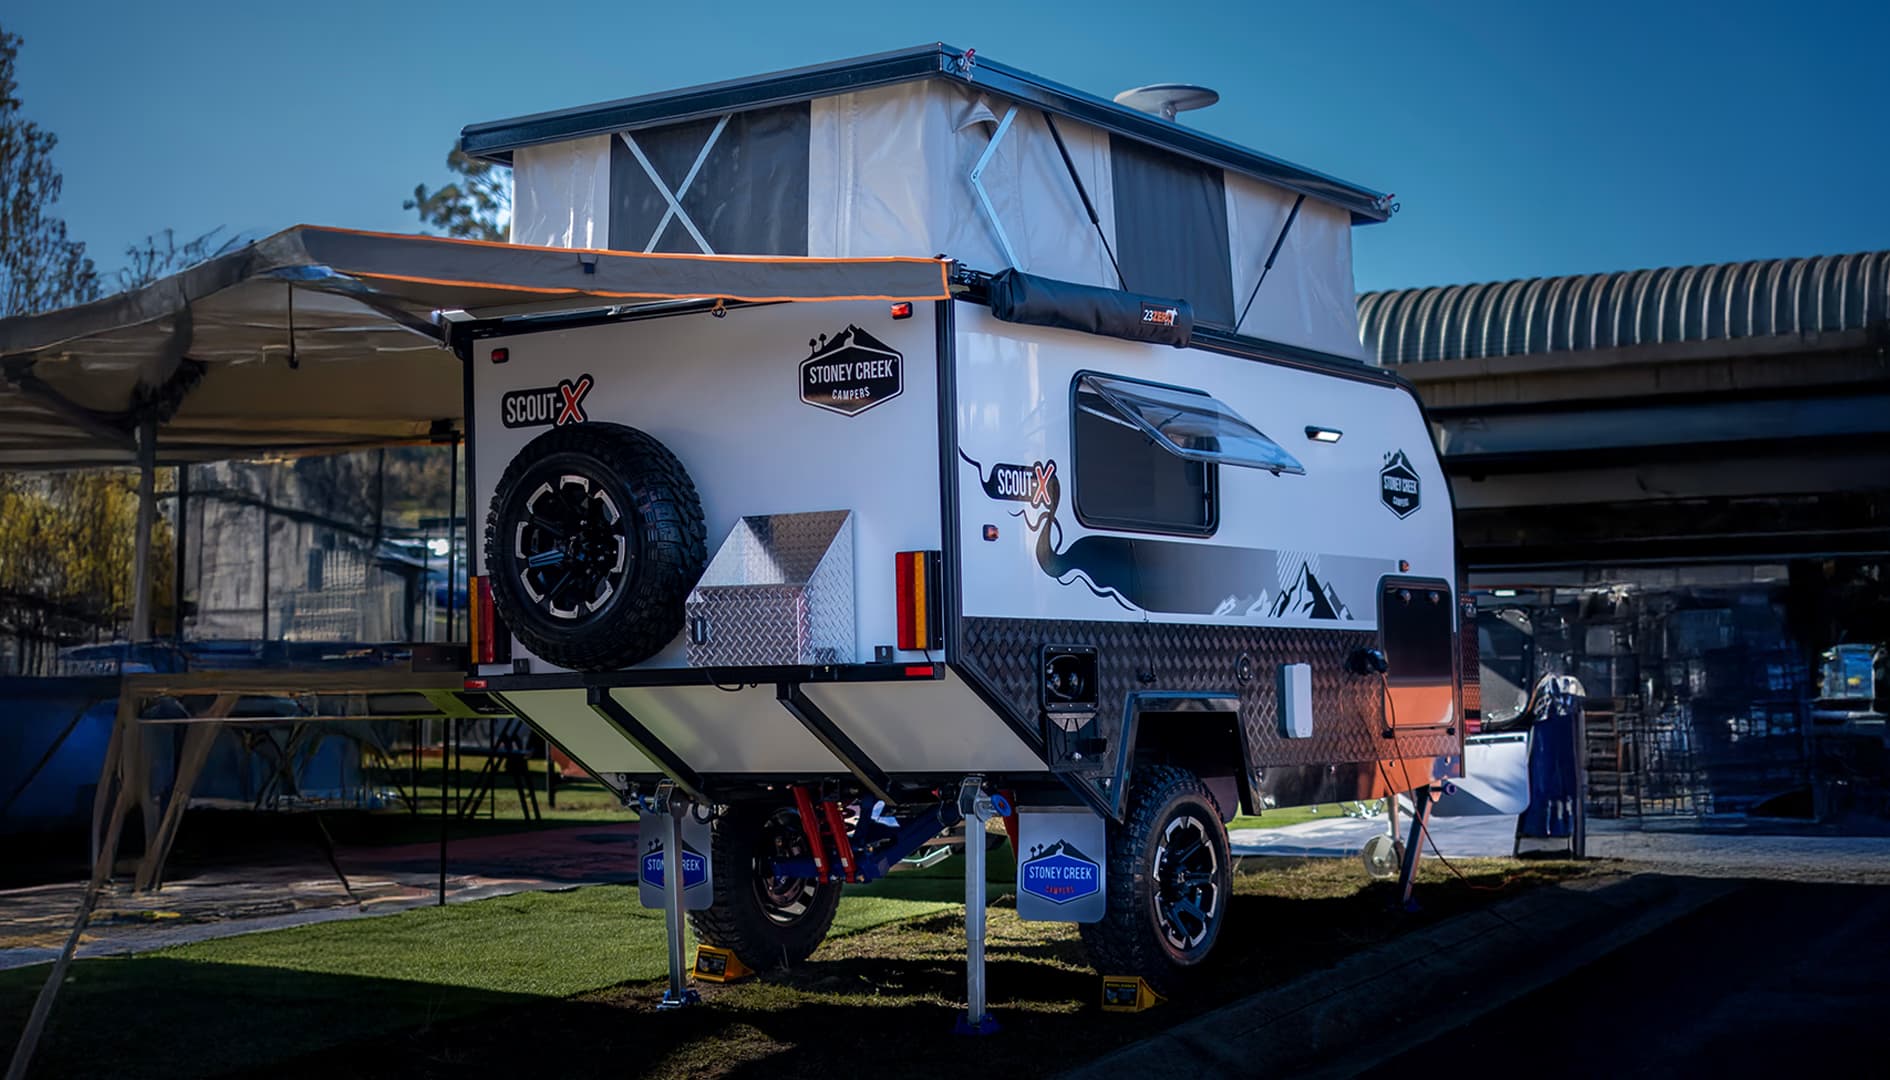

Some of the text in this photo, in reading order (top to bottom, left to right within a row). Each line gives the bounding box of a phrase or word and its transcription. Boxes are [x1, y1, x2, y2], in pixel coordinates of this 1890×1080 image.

[809, 359, 893, 384] STONEY CREEK
[506, 379, 590, 425] SCOUT-X
[832, 386, 871, 400] CAMPERS
[997, 464, 1055, 505] SCOUT-X
[682, 859, 701, 871] REEK
[1029, 865, 1092, 880] STONEY CREEK
